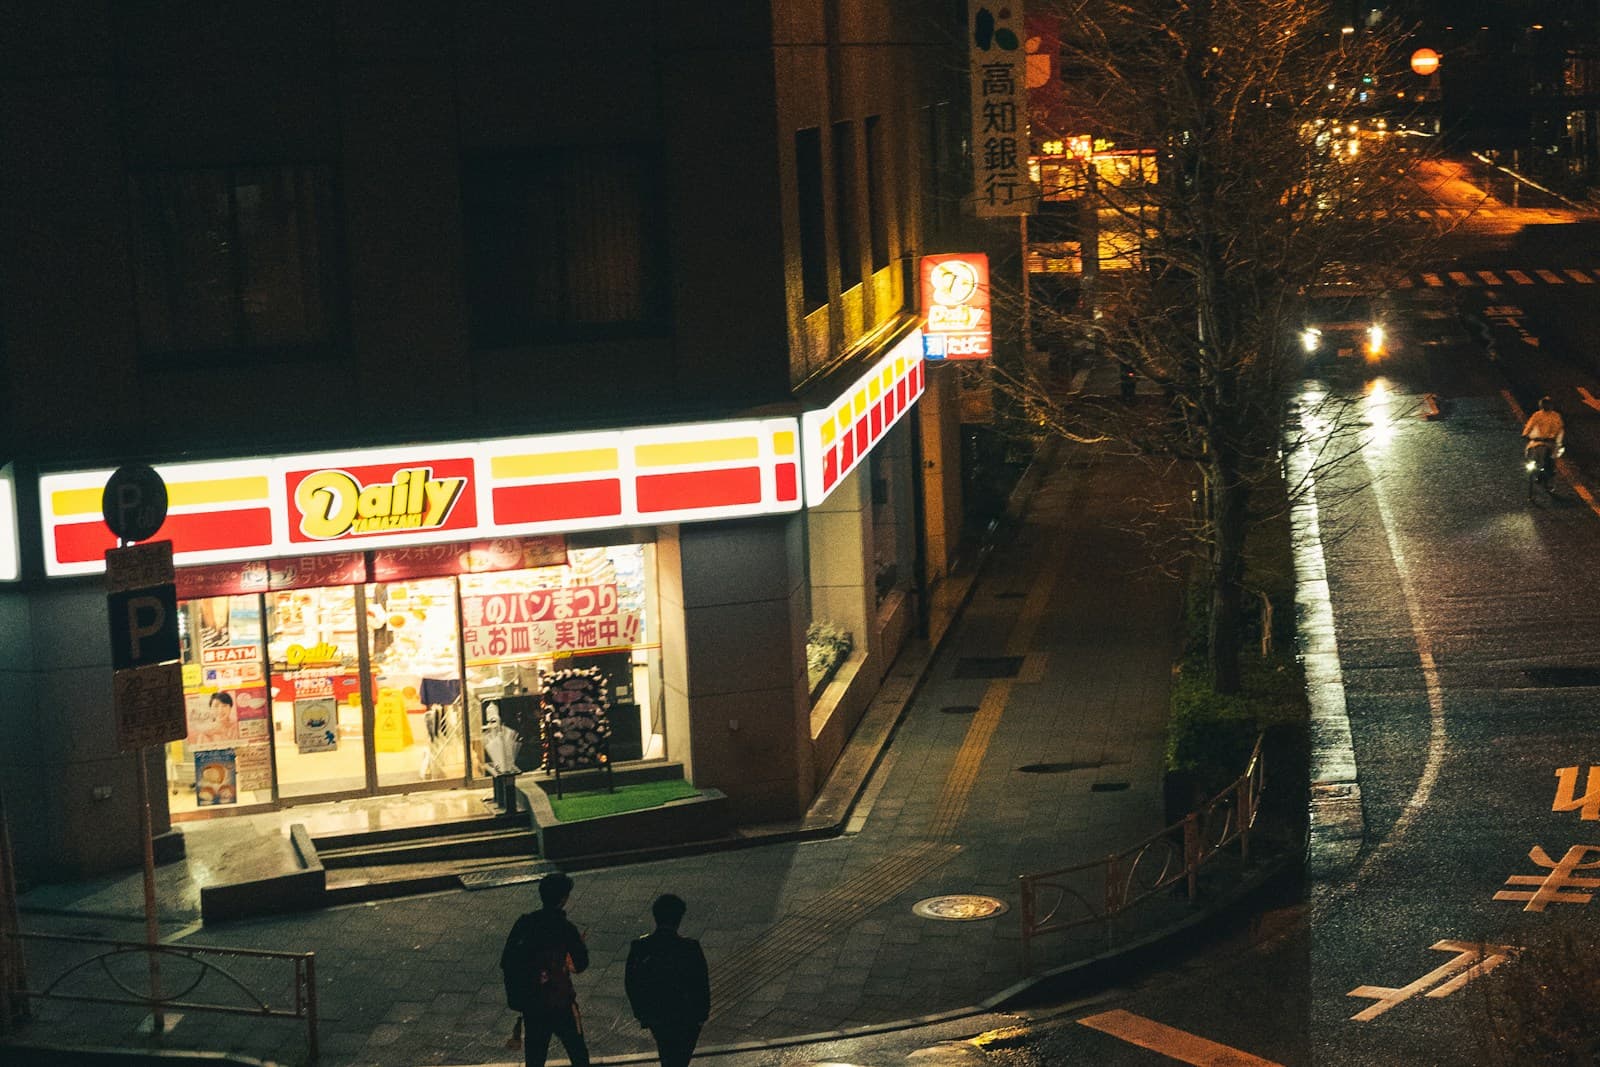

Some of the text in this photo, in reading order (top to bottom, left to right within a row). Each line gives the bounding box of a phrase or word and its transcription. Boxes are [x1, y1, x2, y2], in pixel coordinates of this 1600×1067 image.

[983, 61, 1018, 207] 高知銀行
[296, 468, 466, 538] Daily
[352, 513, 422, 533] YAMAZAKI
[127, 597, 166, 660] P
[463, 585, 618, 628] 春のパンまつり
